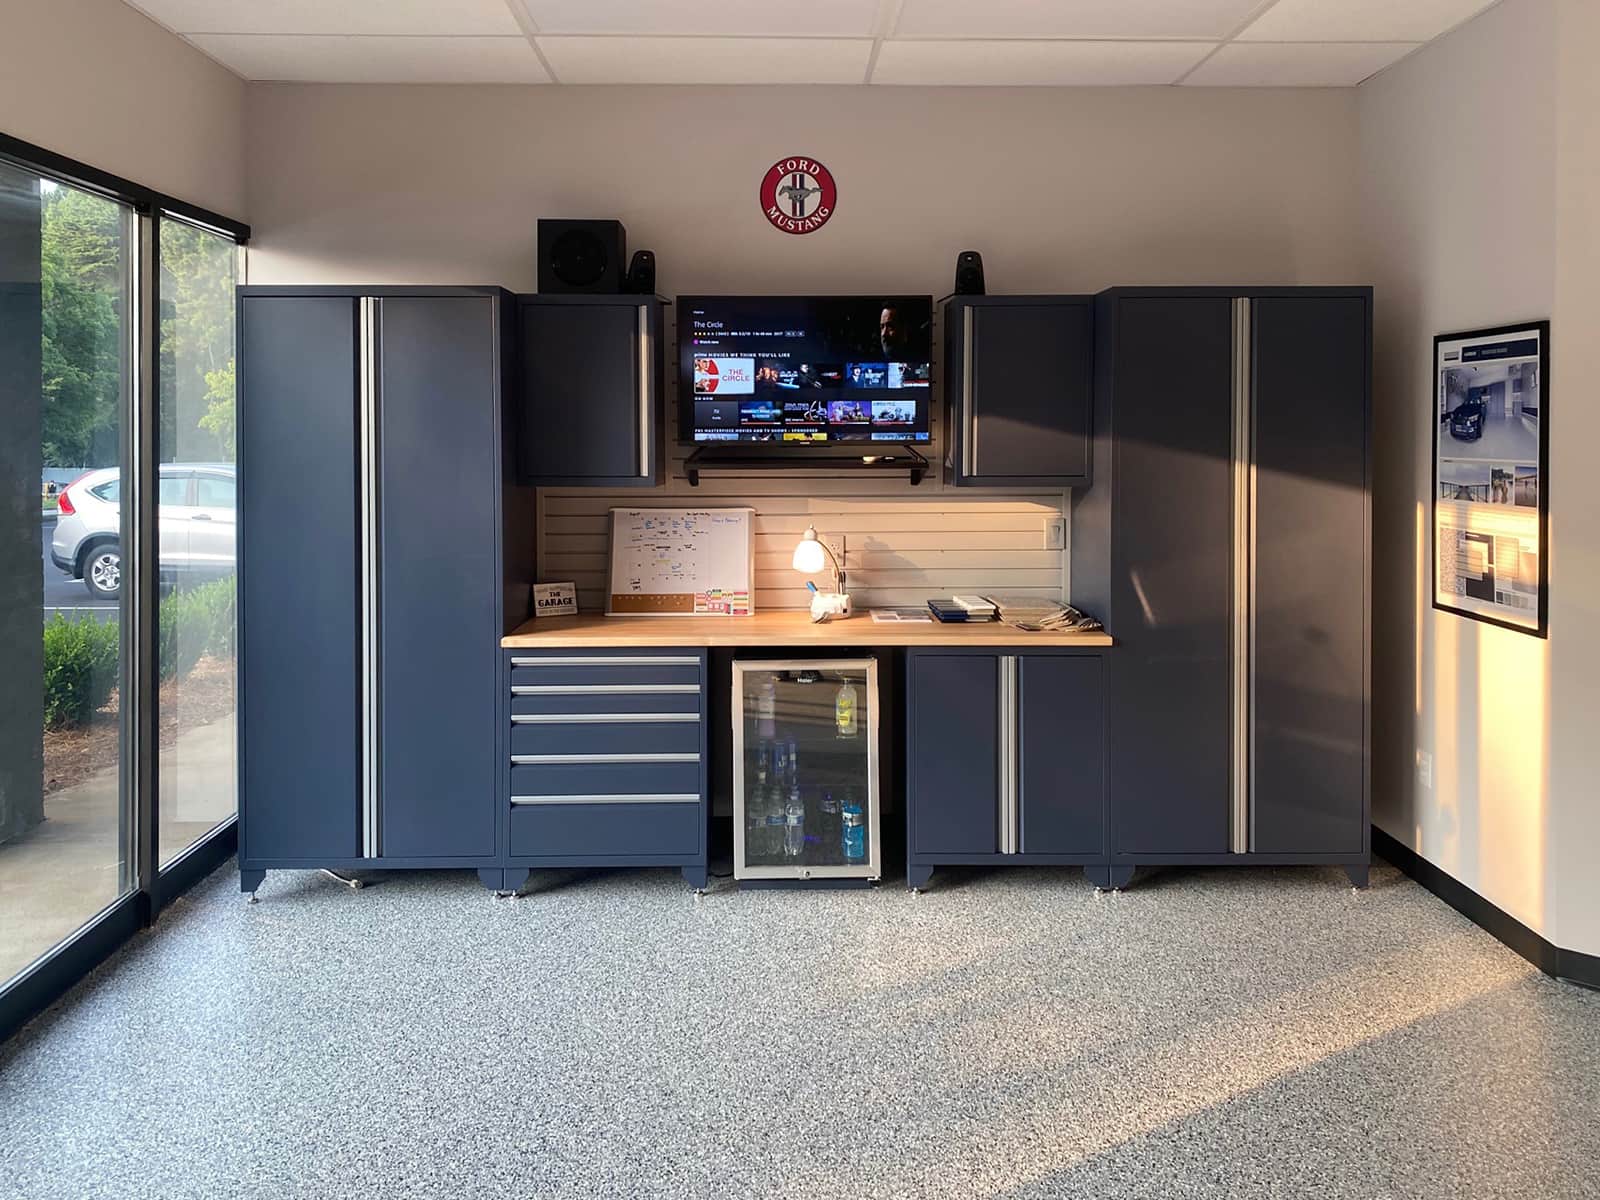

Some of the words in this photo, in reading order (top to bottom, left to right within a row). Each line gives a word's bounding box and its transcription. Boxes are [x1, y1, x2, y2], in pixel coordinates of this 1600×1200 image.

[777, 160, 820, 175] FORD
[767, 206, 829, 231] MUSTANG
[538, 598, 572, 607] GARAGE
